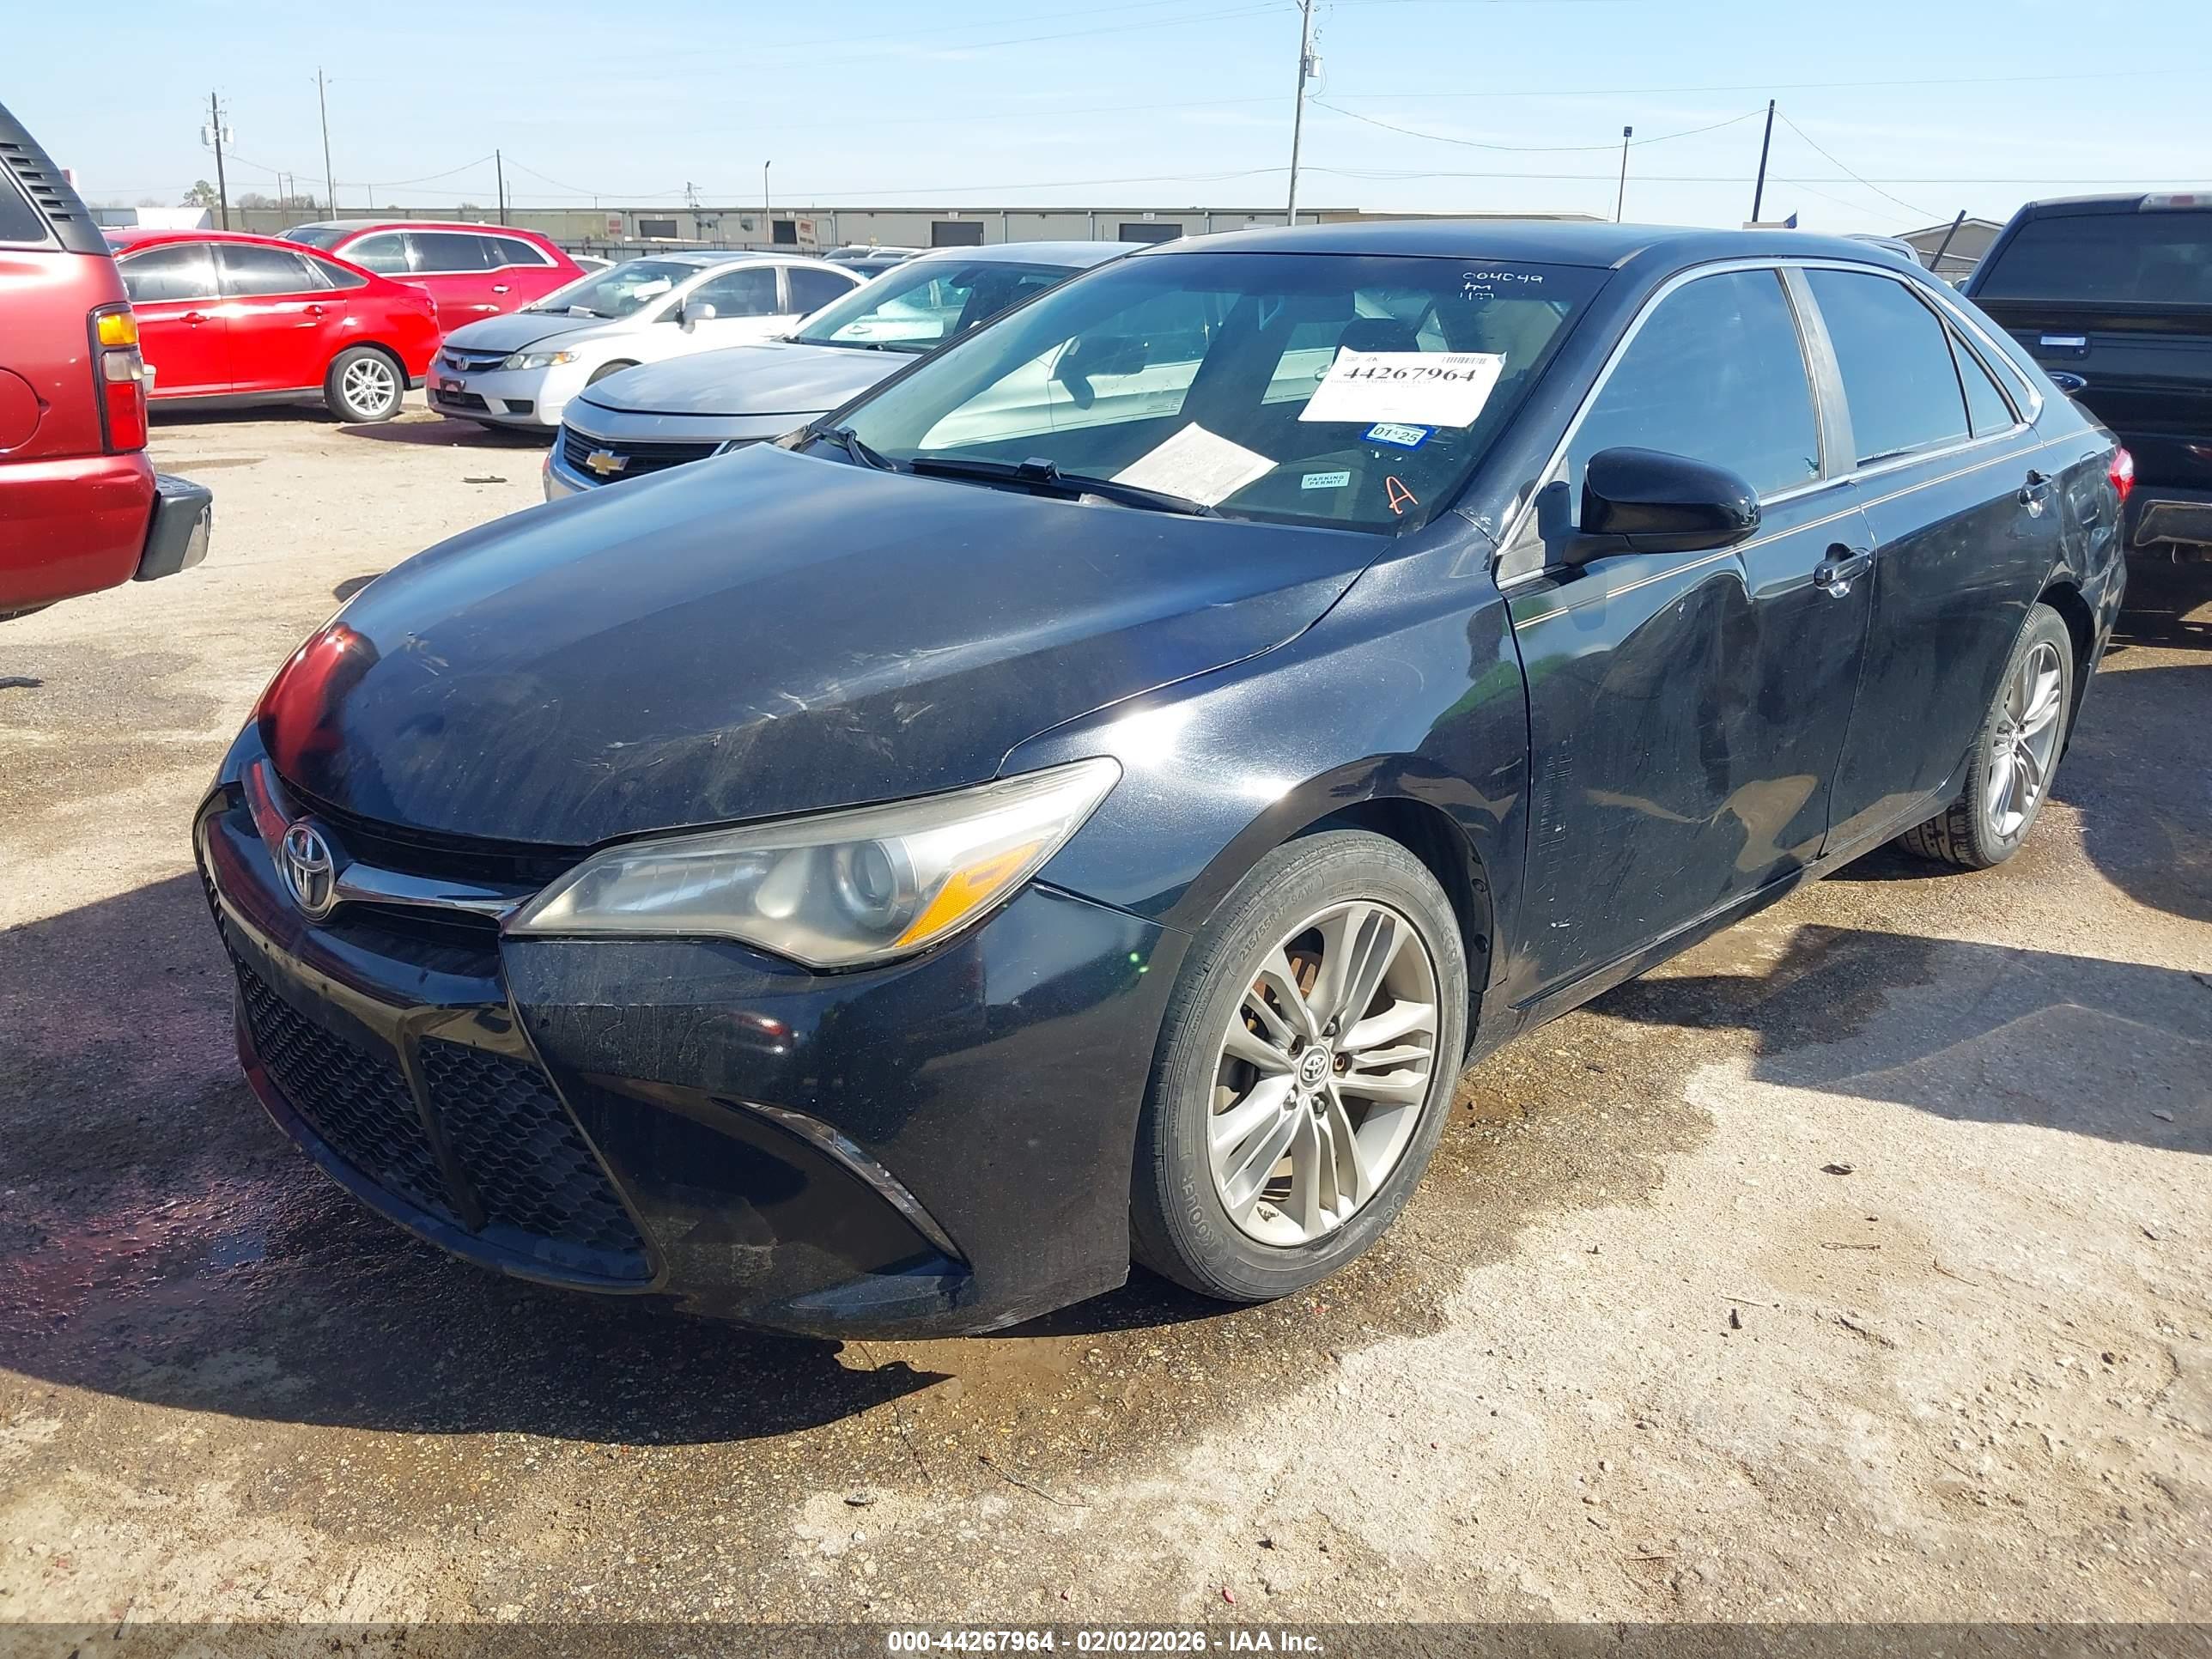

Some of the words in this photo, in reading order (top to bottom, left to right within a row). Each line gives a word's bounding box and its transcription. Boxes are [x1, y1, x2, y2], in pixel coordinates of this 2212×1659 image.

[1343, 367, 1476, 382] 44267964
[1373, 427, 1393, 437] 01
[1397, 431, 1420, 442] 25
[1385, 475, 1419, 514] A
